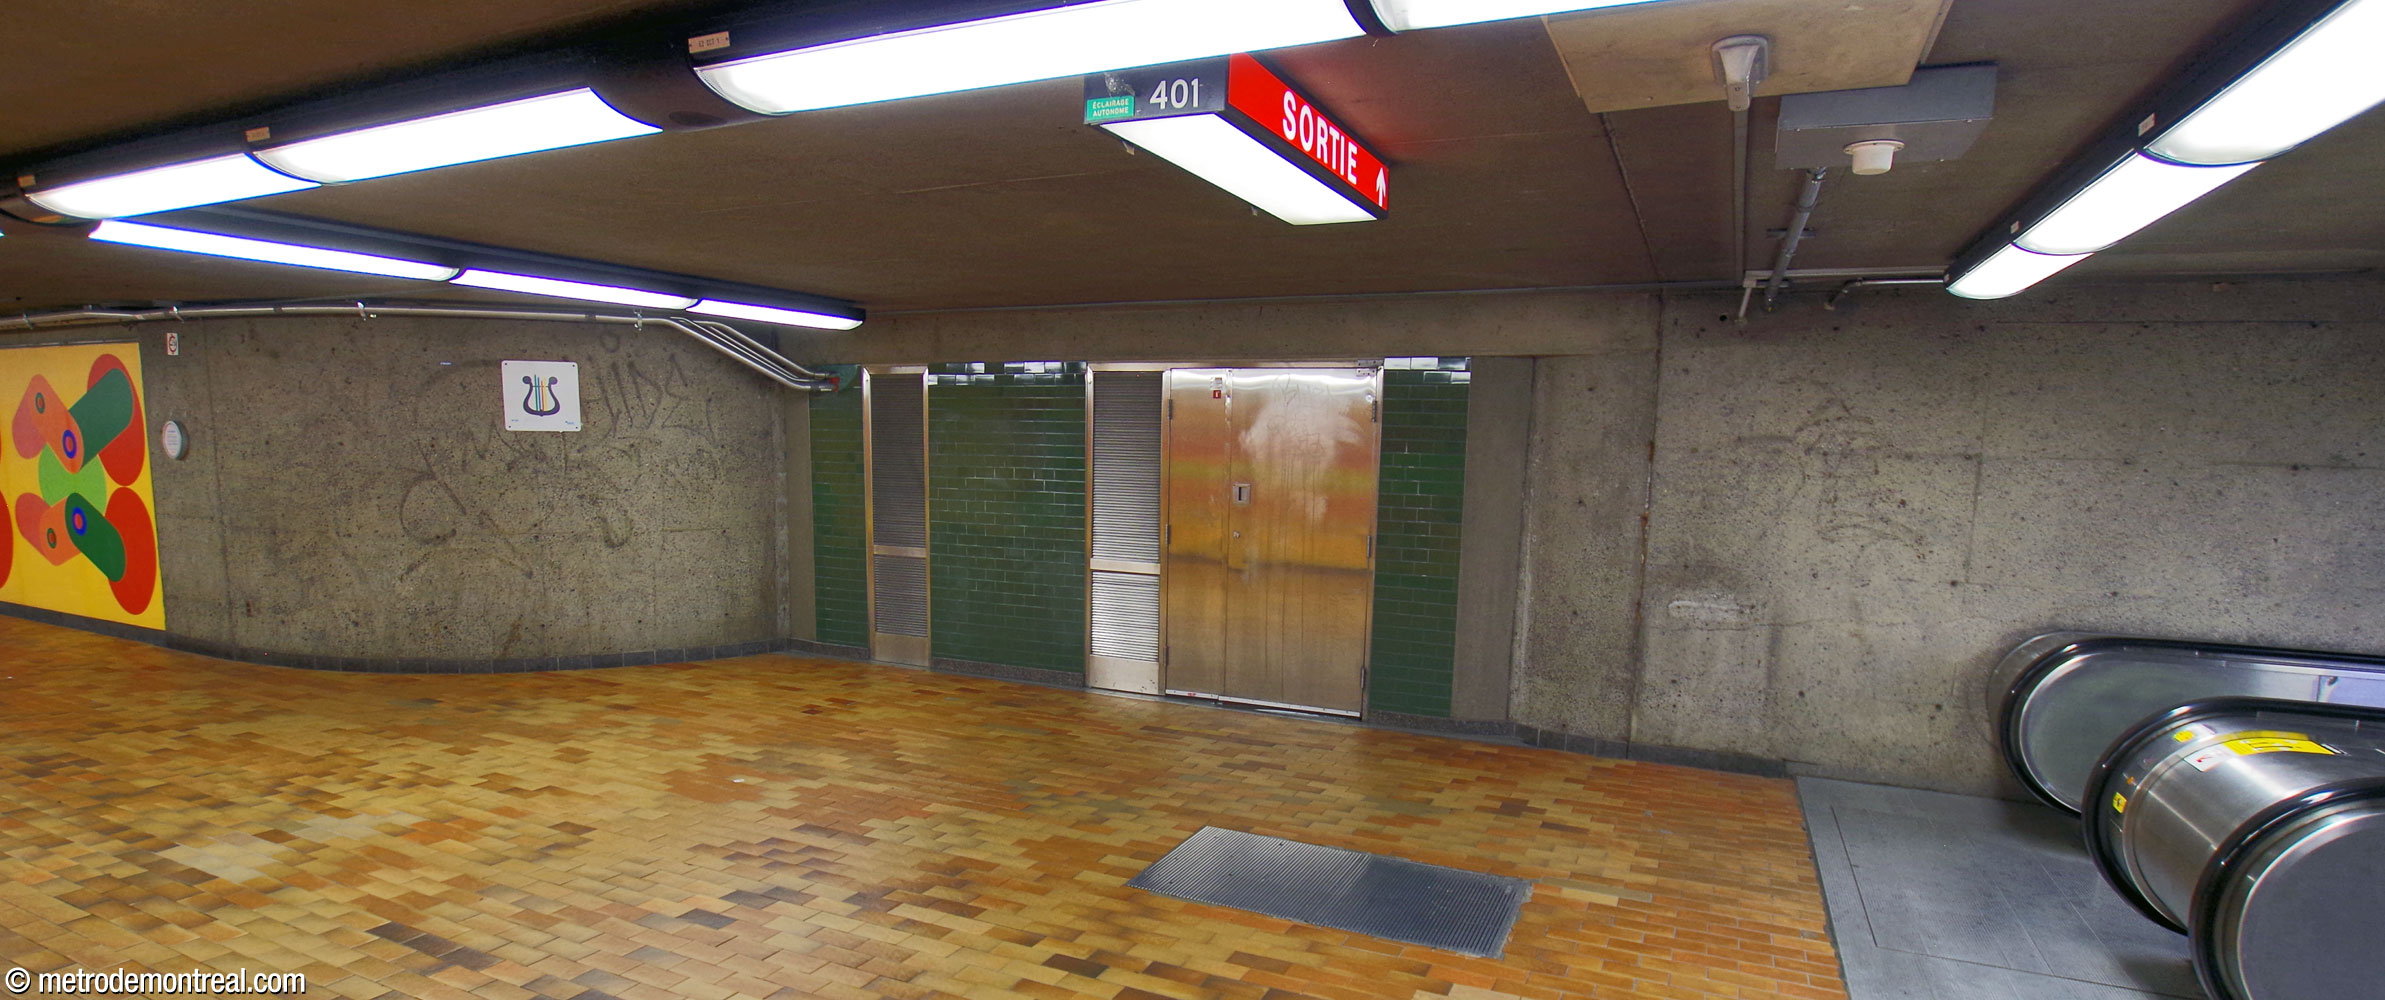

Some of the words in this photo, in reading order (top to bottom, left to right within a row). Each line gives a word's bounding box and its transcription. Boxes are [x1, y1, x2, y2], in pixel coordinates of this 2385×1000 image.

[1092, 98, 1129, 110] ÉCLAIRAGE
[1149, 78, 1199, 110] 401
[1092, 106, 1129, 117] AUTONOME
[1282, 90, 1358, 185] SORTIE
